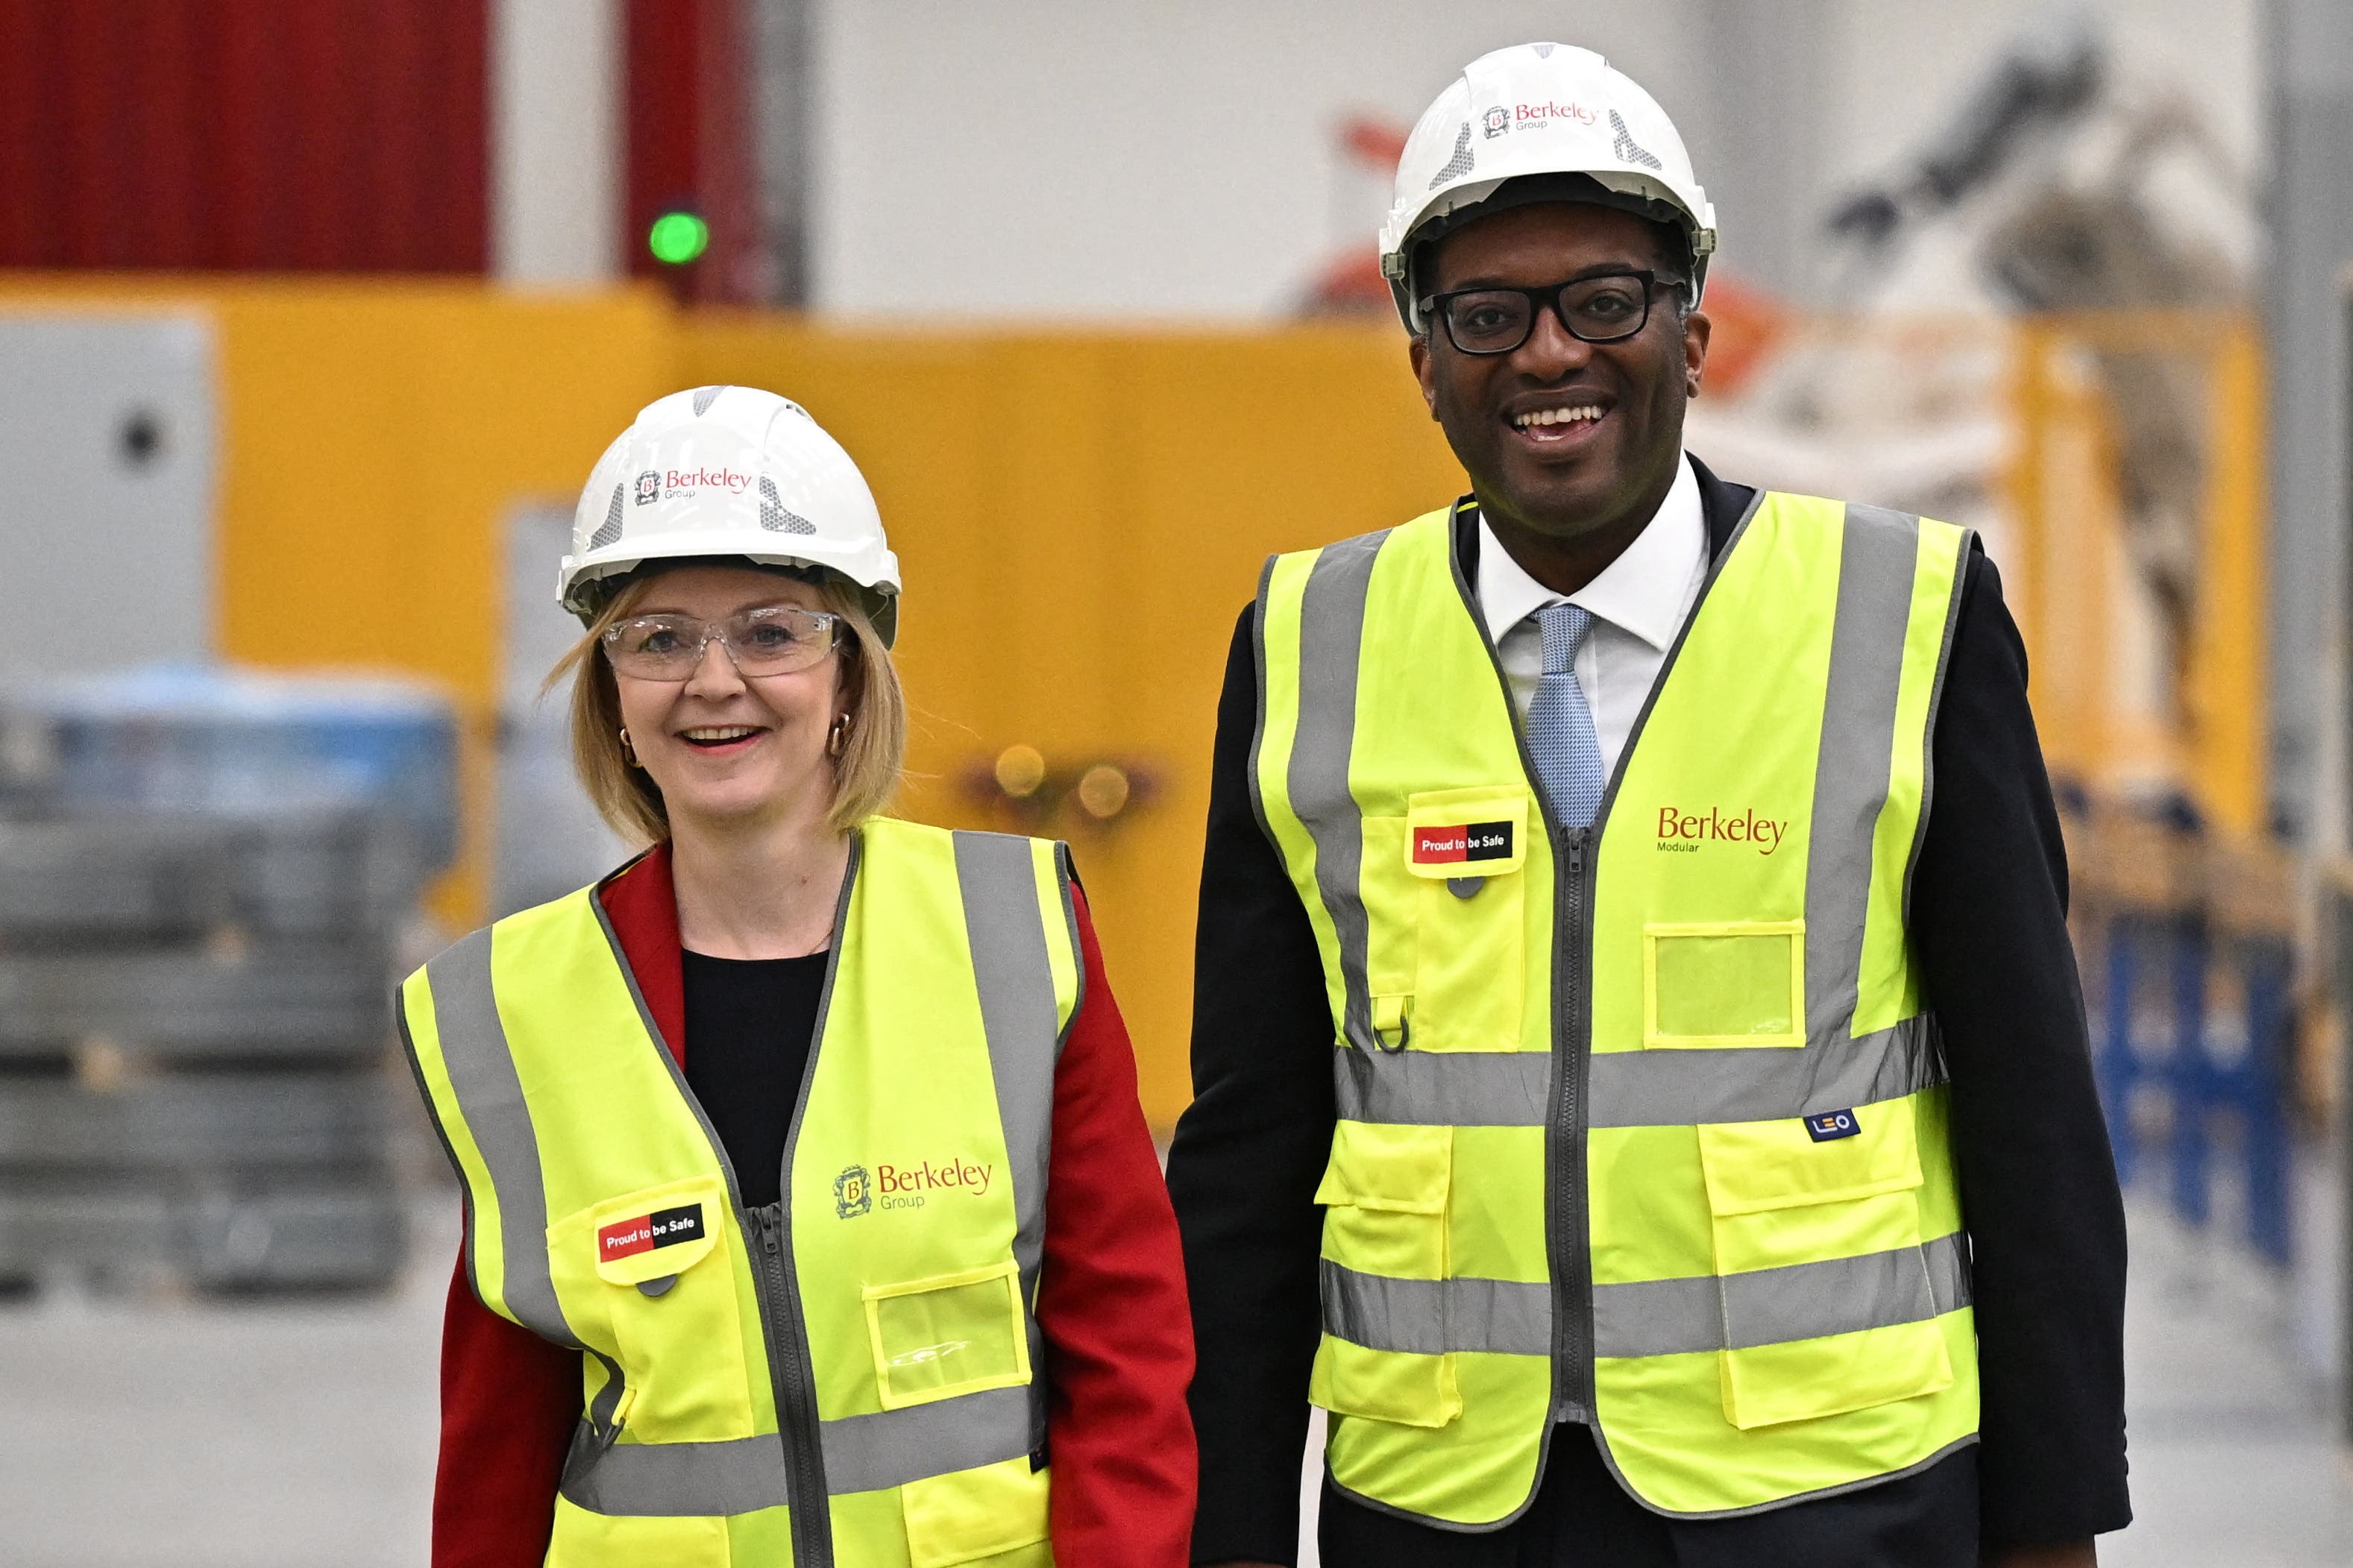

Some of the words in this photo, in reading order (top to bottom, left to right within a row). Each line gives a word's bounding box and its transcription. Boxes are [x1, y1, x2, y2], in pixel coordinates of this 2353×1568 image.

[1492, 114, 1501, 126] B
[1516, 101, 1599, 126] Berkeley
[1516, 120, 1548, 131] Group
[644, 479, 653, 492] B
[666, 467, 752, 494] Berkeley
[665, 489, 696, 499] Group
[1658, 807, 1788, 855] Berkeley
[1421, 840, 1454, 851] Proud
[1455, 839, 1465, 849] to
[1468, 837, 1480, 848] be
[1483, 835, 1504, 847] Safe
[1657, 842, 1700, 852] Modular
[1812, 1115, 1850, 1133] LEO
[878, 1158, 992, 1195] Berkeley
[848, 1181, 859, 1200] B
[880, 1195, 925, 1209] Group
[606, 1230, 638, 1249] Proud
[639, 1229, 650, 1240] to
[652, 1225, 667, 1235] be
[669, 1218, 694, 1232] Safe
